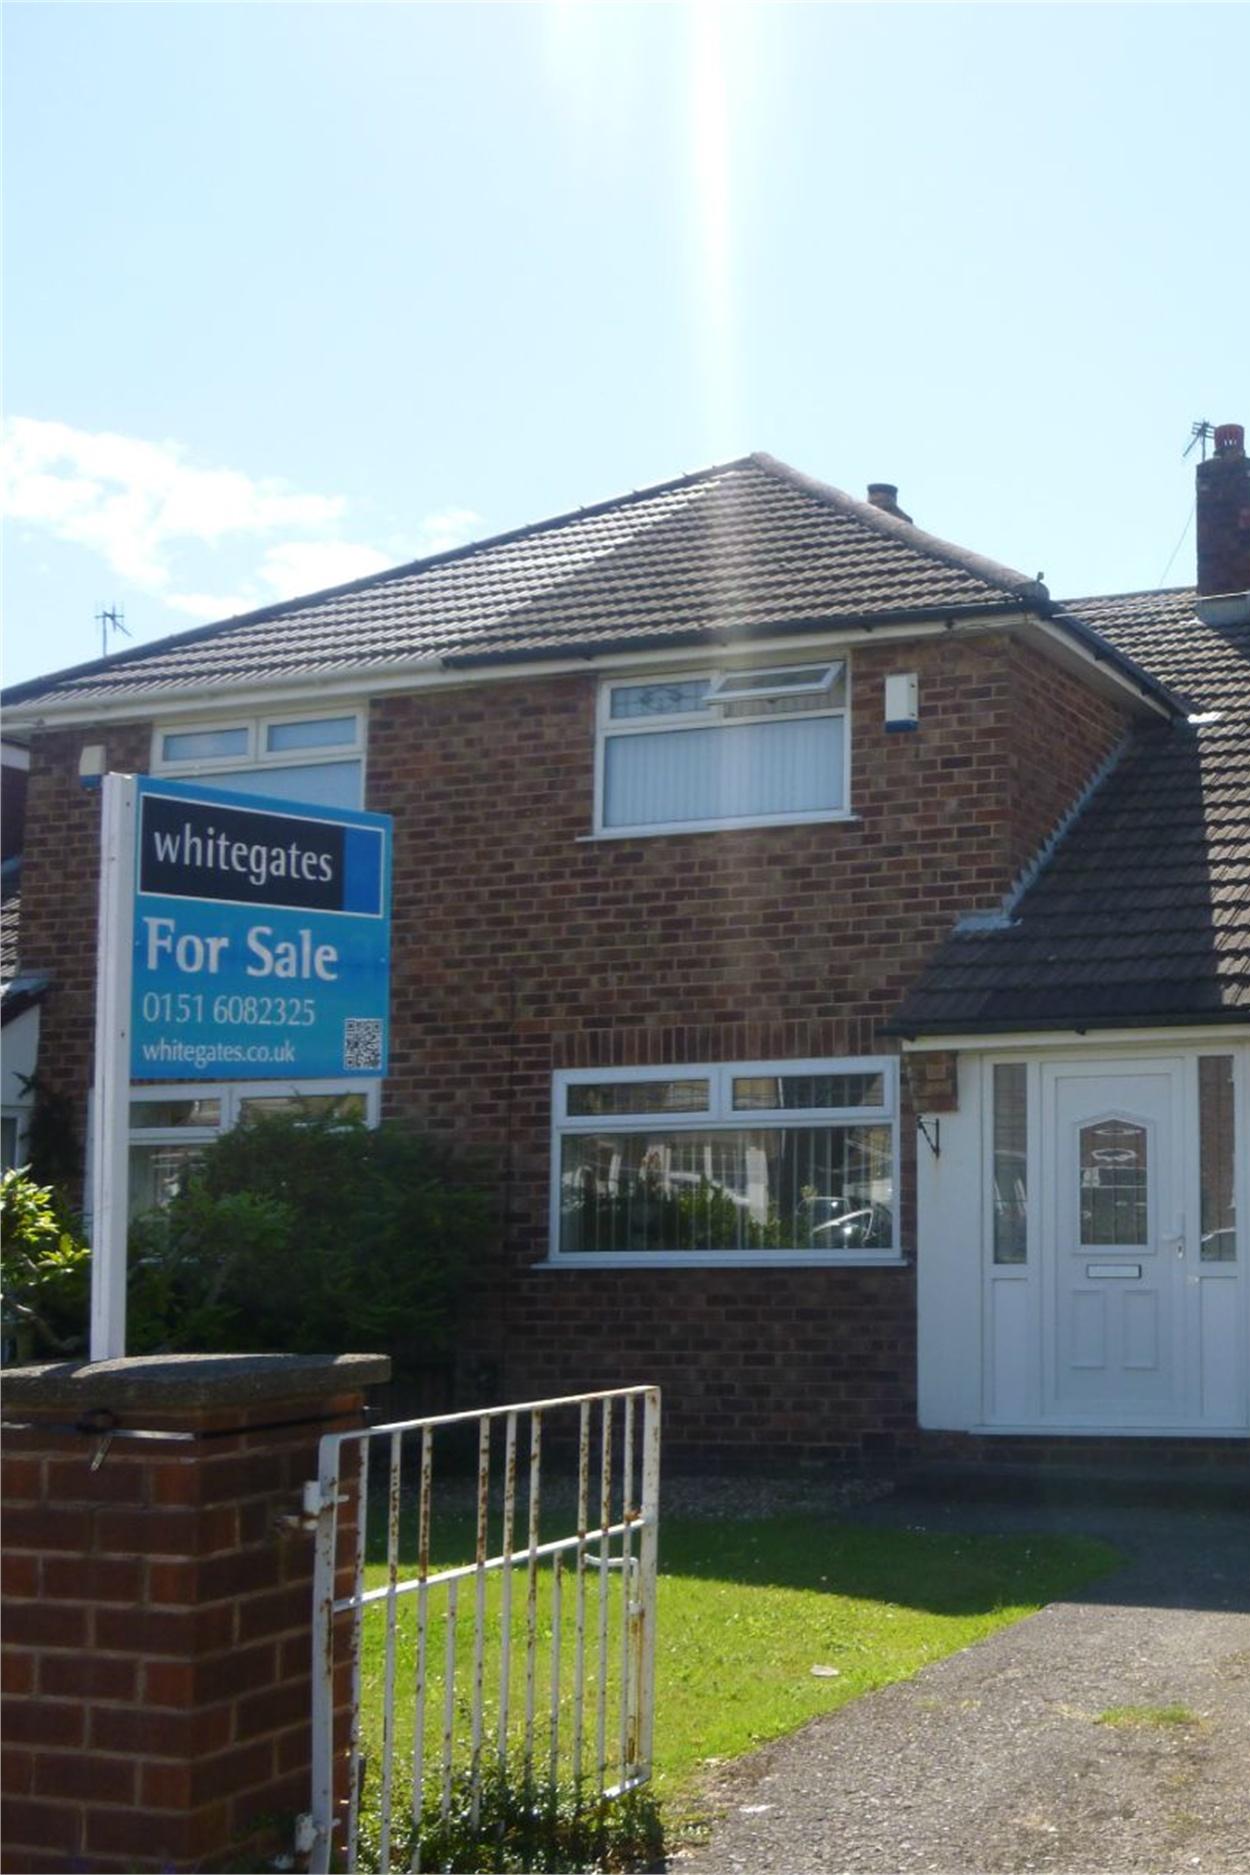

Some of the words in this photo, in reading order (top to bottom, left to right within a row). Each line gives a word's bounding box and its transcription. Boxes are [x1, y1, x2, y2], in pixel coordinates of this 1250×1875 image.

[154, 823, 333, 886] whitegates
[143, 916, 229, 974] For
[246, 926, 339, 981] Sale
[142, 991, 203, 1024] 0151
[213, 995, 316, 1026] 6082325
[142, 1037, 296, 1070] whitegates.co.uk
